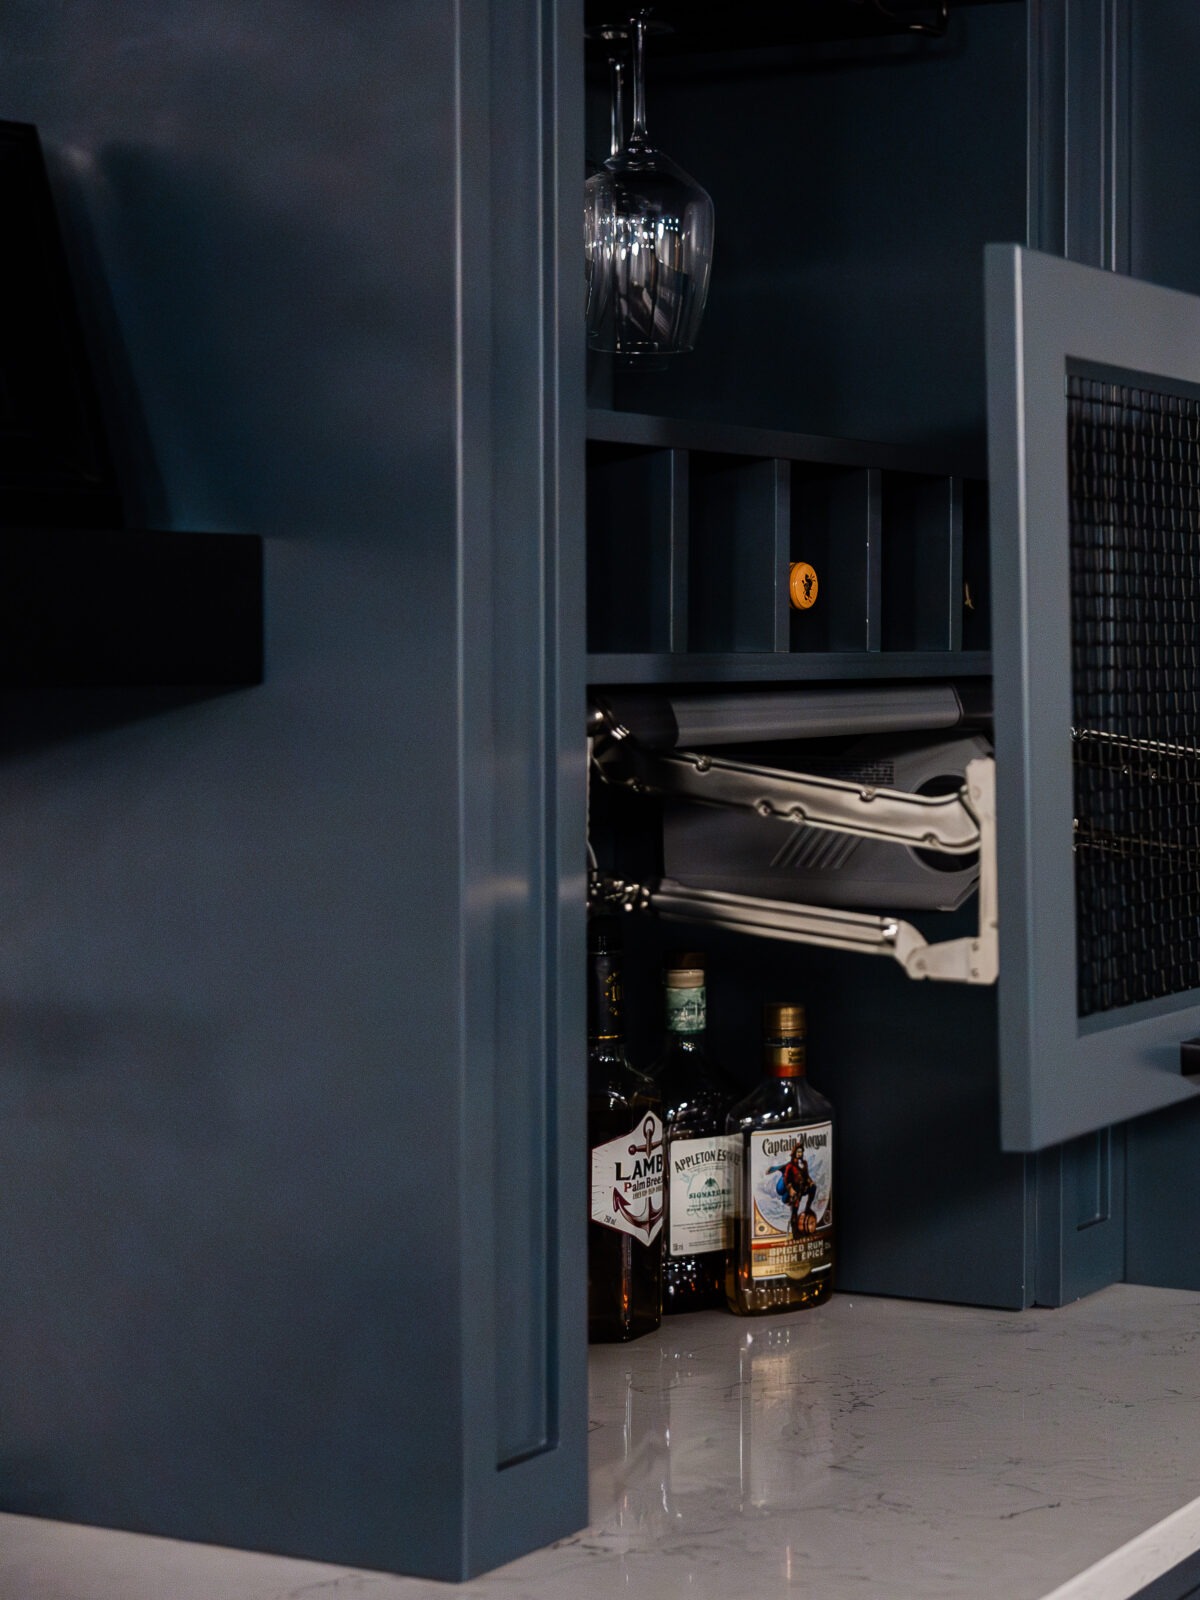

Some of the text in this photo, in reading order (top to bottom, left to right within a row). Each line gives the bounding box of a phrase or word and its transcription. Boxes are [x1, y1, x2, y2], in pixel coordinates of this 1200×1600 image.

[762, 1132, 827, 1157] Captain Morgan
[615, 1154, 663, 1181] LAMB
[674, 1149, 716, 1174] APPLETON
[624, 1180, 646, 1193] Palm
[769, 1244, 805, 1257] SPICED
[807, 1239, 824, 1250] RUM
